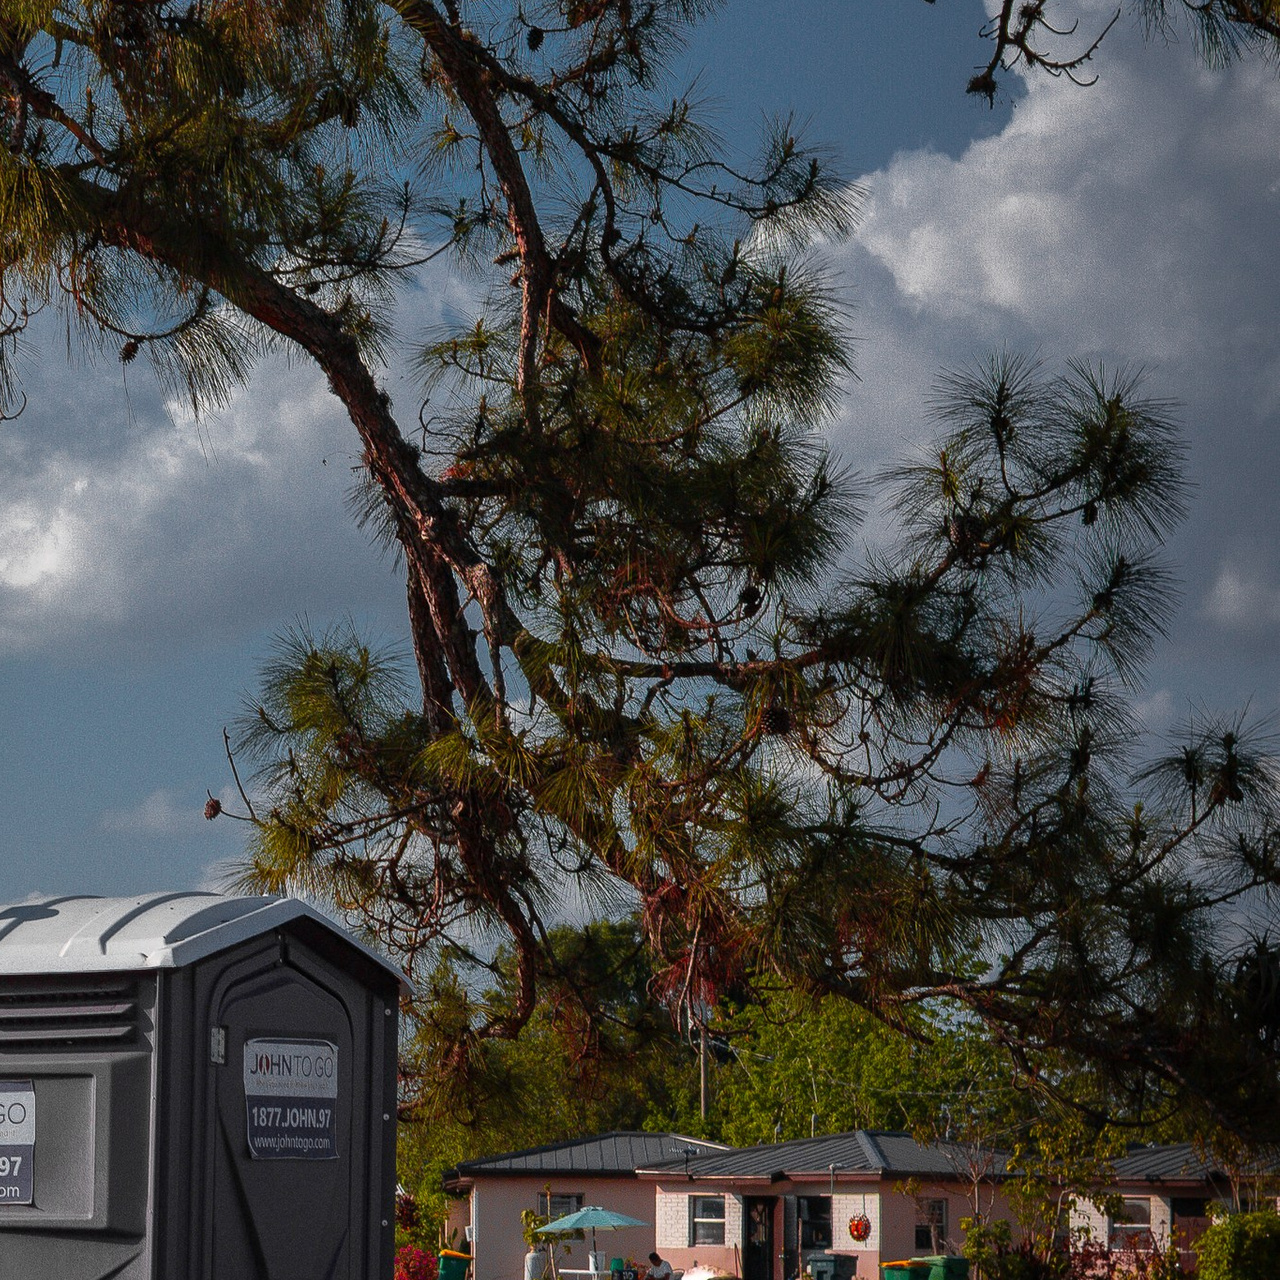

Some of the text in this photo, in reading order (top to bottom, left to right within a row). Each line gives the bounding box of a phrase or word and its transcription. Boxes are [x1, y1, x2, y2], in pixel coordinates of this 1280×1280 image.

[315, 1057, 333, 1078] GO
[252, 1107, 331, 1128] 1877.JOHN.97
[254, 1134, 330, 1152] www.johntogo.com
